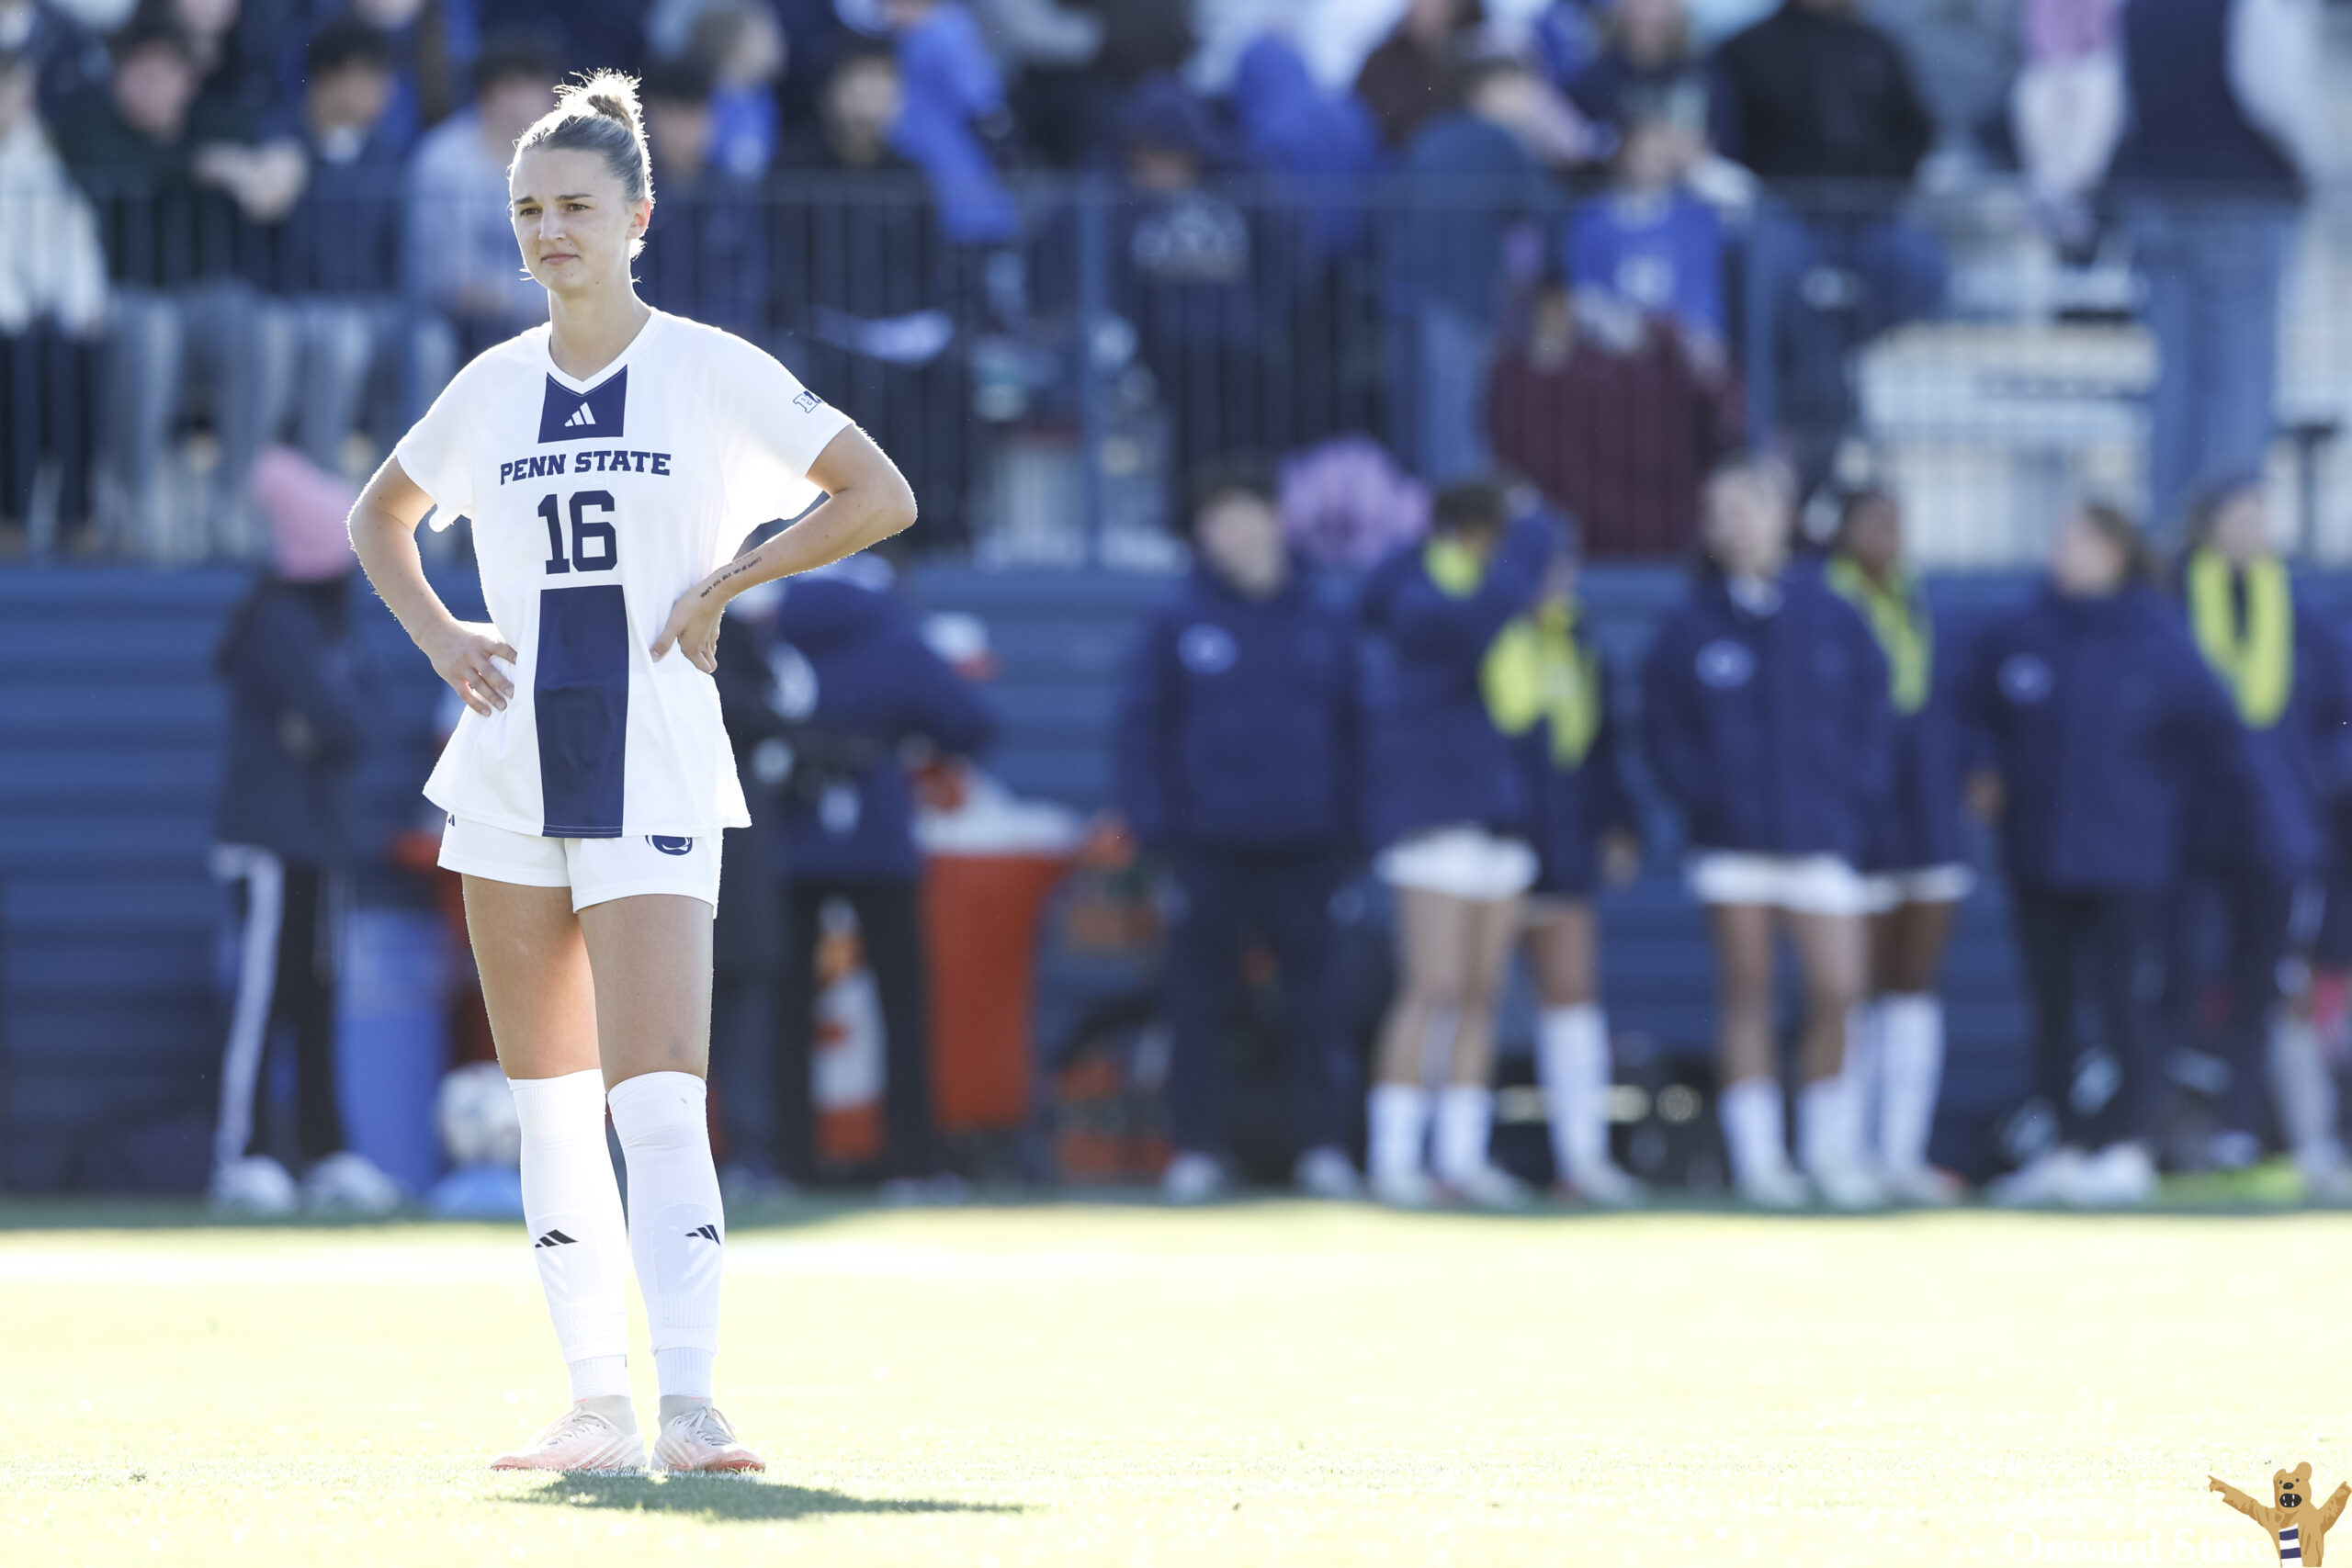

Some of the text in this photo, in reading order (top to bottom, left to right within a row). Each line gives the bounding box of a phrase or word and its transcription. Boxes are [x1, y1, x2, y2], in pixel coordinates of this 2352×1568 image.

[500, 450, 672, 486] PENN STATE
[537, 490, 618, 575] 16
